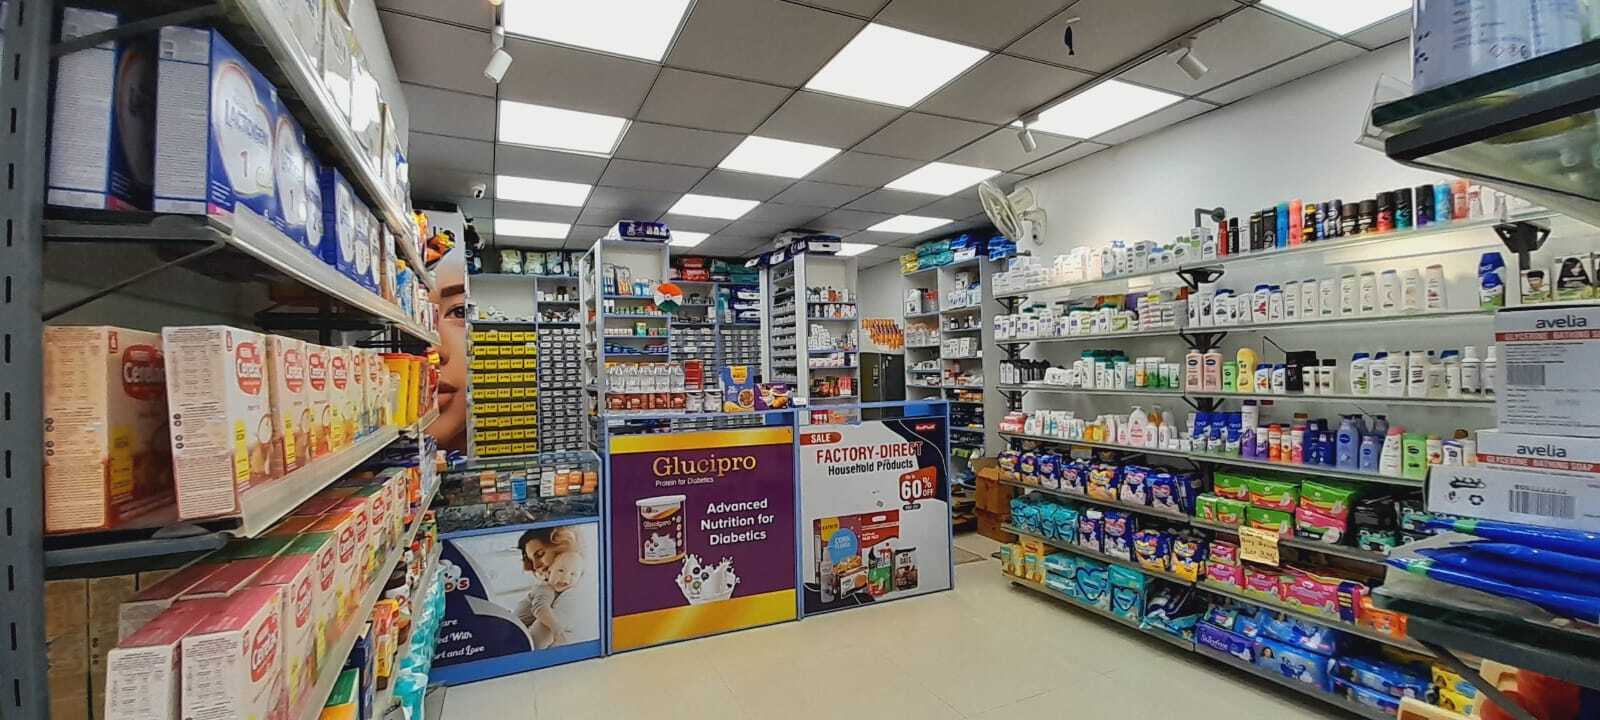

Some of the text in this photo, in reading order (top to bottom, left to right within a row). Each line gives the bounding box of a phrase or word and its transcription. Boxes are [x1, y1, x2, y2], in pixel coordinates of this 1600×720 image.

[241, 151, 248, 177] 1
[1536, 315, 1587, 328] avelia
[811, 433, 831, 443] SALE
[816, 441, 924, 464] FACTORY-DIRECT
[1516, 444, 1567, 457] avelia
[653, 454, 757, 477] Glucipro
[828, 459, 914, 476] Household Products
[1570, 462, 1594, 471] SOAP
[655, 479, 677, 487] Protein
[687, 476, 714, 485] Diabetics
[707, 498, 768, 514] Advanced
[701, 513, 774, 530] Nutrition for
[709, 530, 767, 545] Diabetics
[450, 631, 472, 641] With
[447, 649, 464, 657] and
[466, 644, 485, 656] Love
